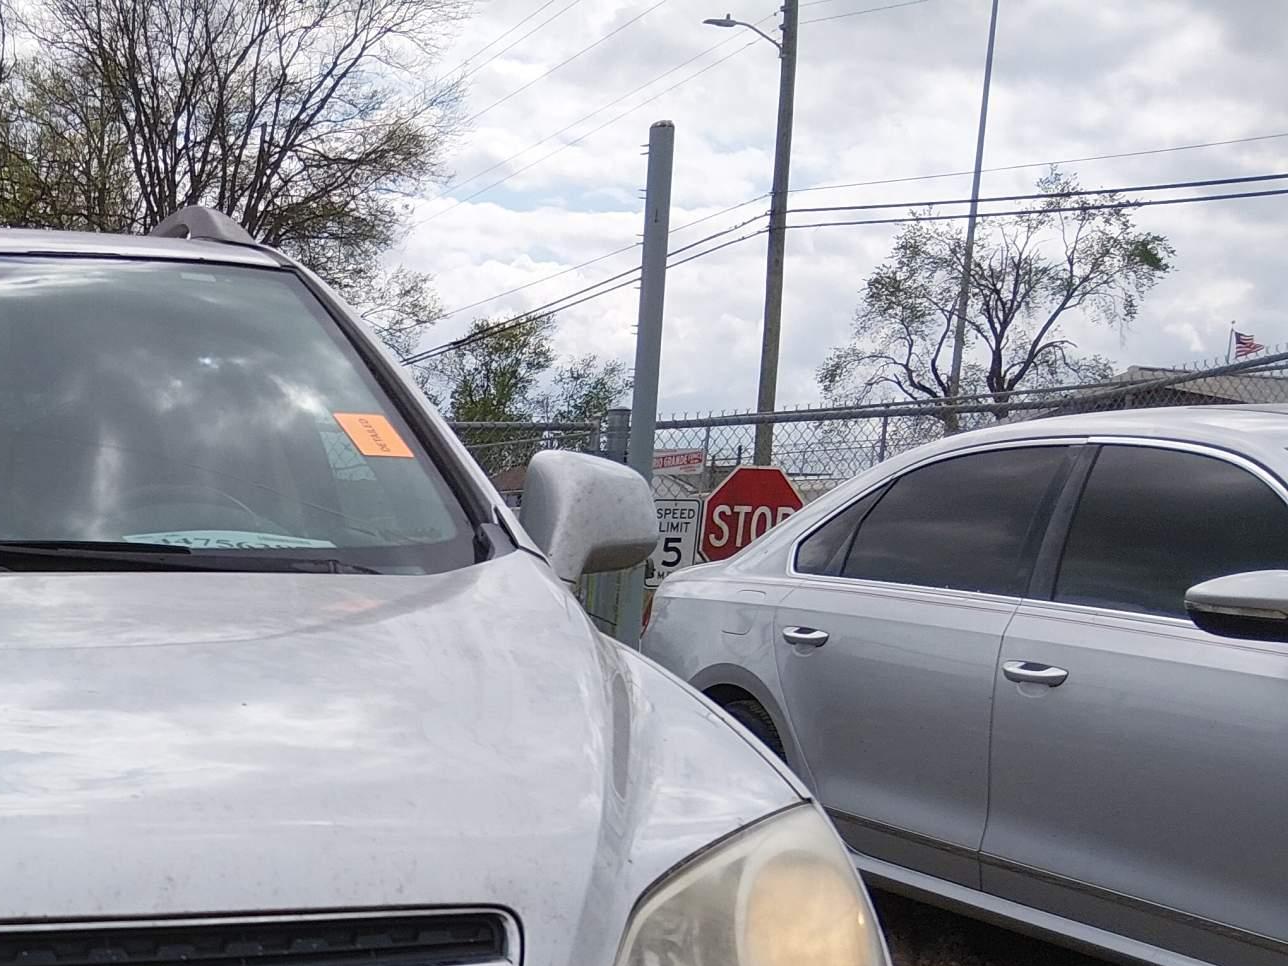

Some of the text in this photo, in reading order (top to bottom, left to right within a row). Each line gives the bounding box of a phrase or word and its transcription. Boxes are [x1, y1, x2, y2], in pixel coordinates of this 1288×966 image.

[358, 418, 391, 453] DETAILED
[664, 454, 688, 467] GRANDE
[656, 508, 695, 520] SPEED
[658, 521, 691, 533] LIMIT
[661, 537, 682, 567] 5
